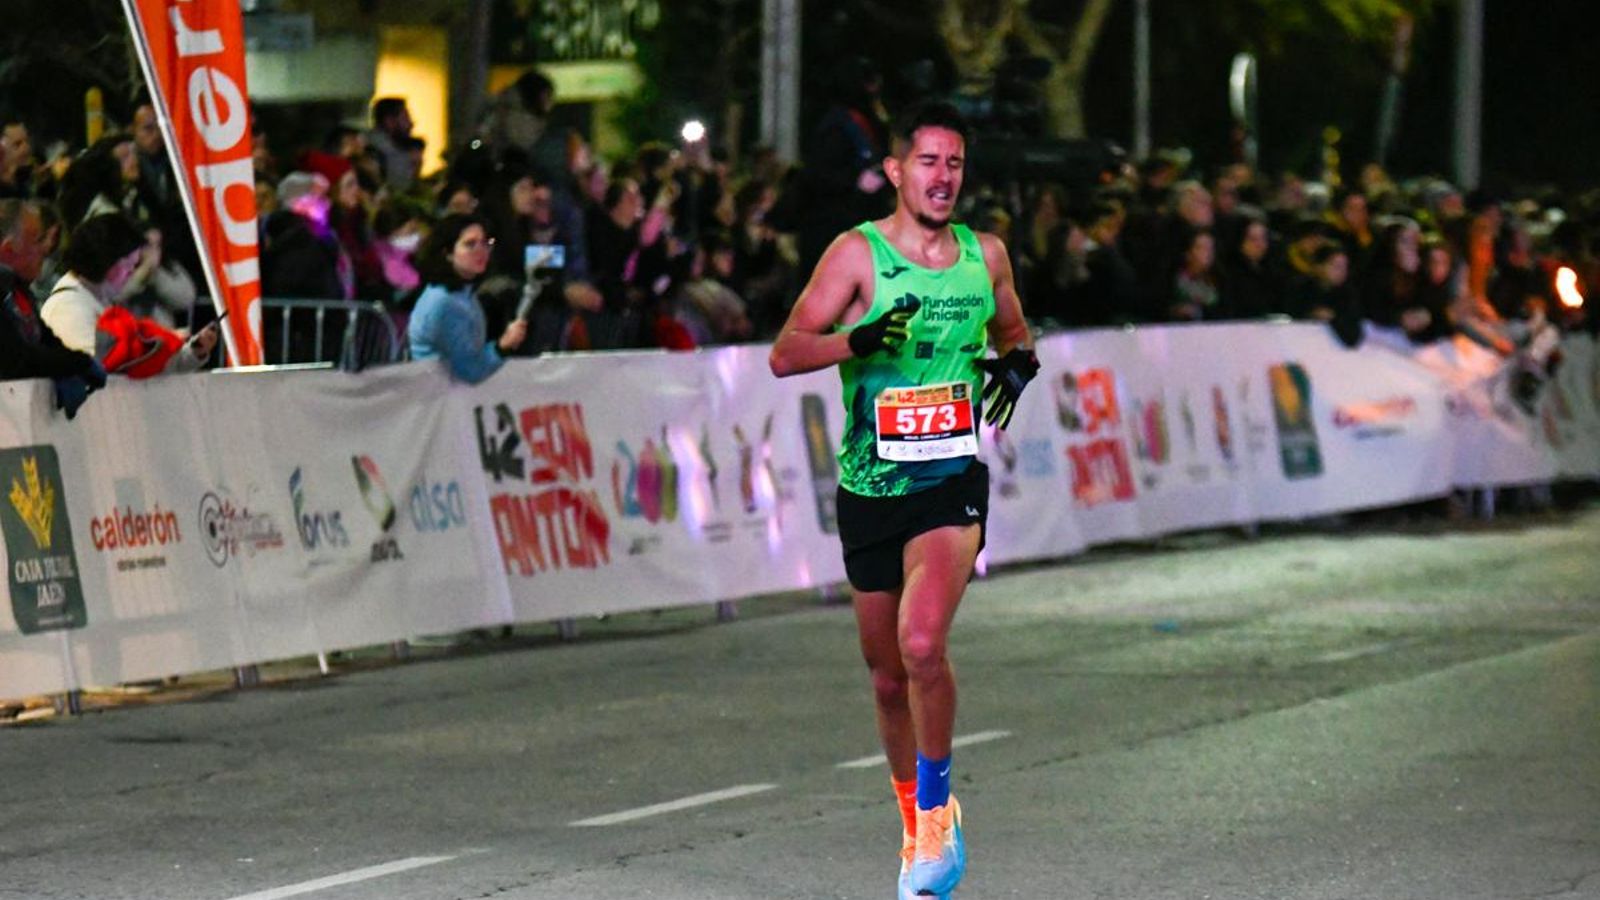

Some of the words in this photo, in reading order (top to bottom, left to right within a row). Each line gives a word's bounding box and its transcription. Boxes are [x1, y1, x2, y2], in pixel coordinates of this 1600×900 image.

[922, 293, 984, 308] Fundación
[922, 309, 970, 324] Unicaja
[897, 389, 915, 403] 42
[896, 404, 957, 434] 573
[474, 403, 525, 484] 42
[91, 504, 181, 550] calderón
